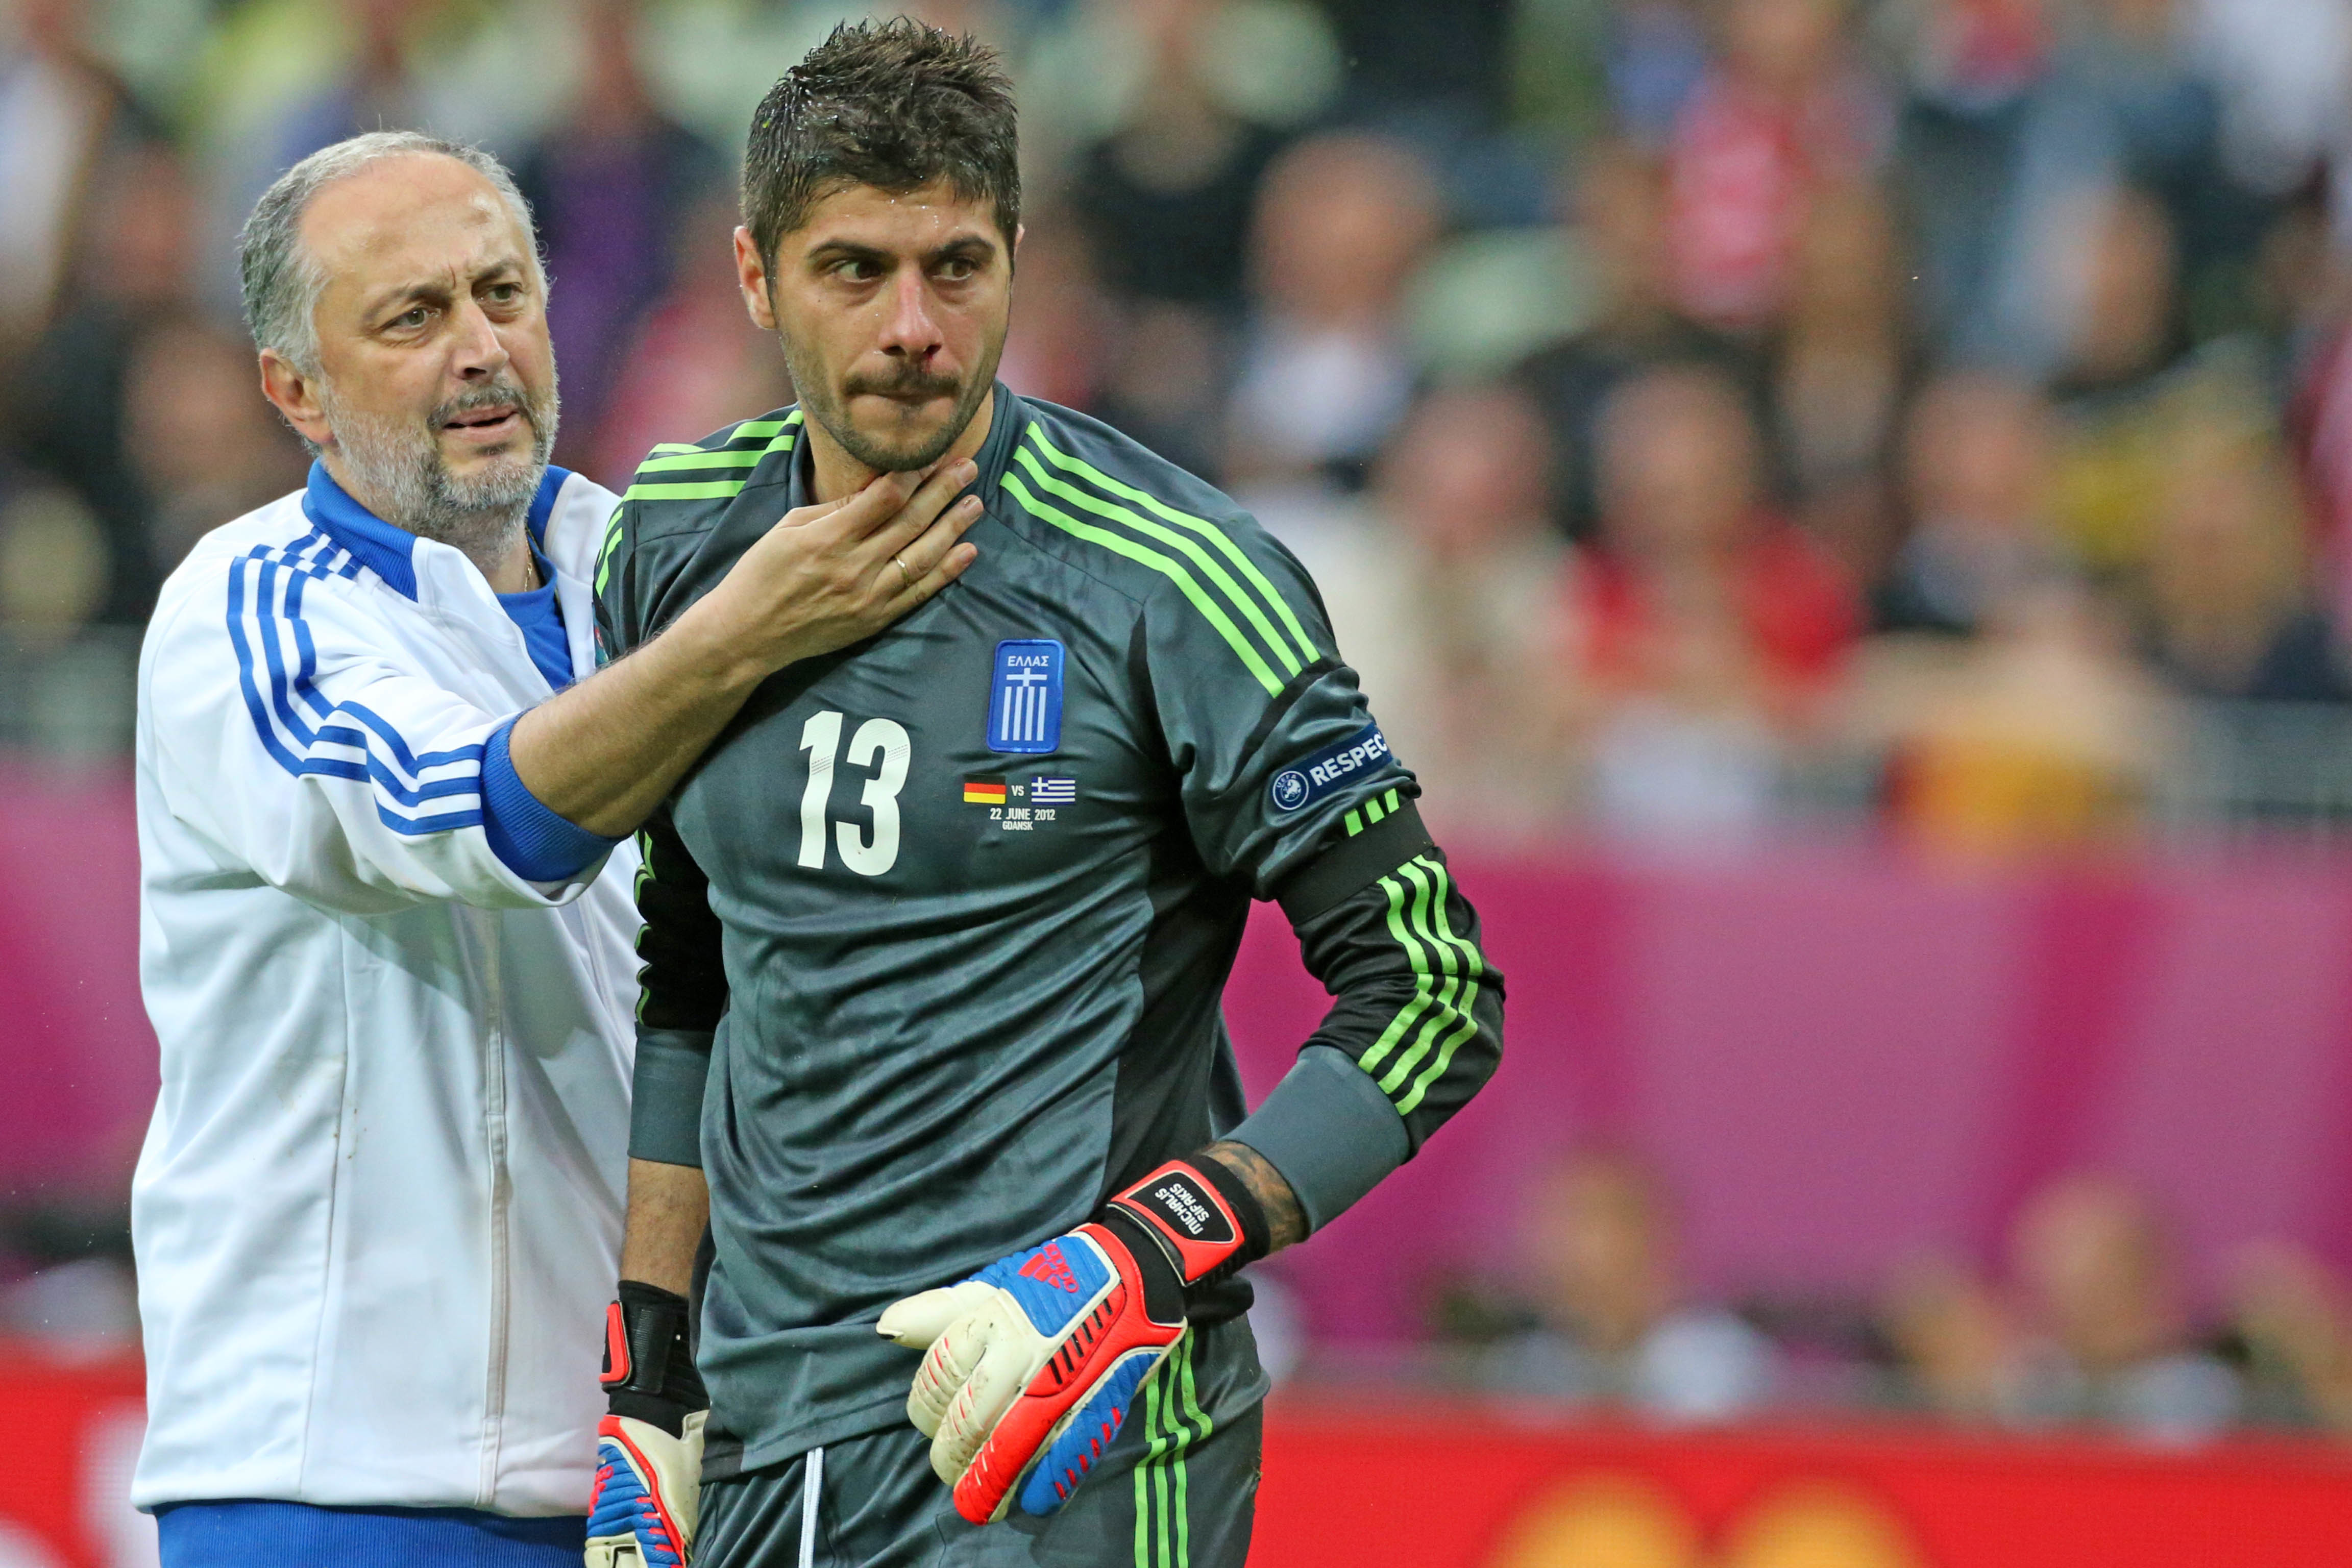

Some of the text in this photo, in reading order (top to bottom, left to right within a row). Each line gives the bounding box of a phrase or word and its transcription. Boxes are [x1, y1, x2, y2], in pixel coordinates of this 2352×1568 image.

[1008, 655, 1049, 667] ΕΛΛΑΣ
[1309, 731, 1388, 786] RESPEC
[798, 710, 911, 876] 13
[1011, 785, 1024, 796] VS
[990, 807, 1056, 821] 22 JUNE 2012
[1002, 821, 1034, 830] GDANSK
[1155, 1187, 1204, 1235] MICHALIS
[1169, 1183, 1210, 1222] SIFAKIS
[1043, 1243, 1080, 1293] adidas
